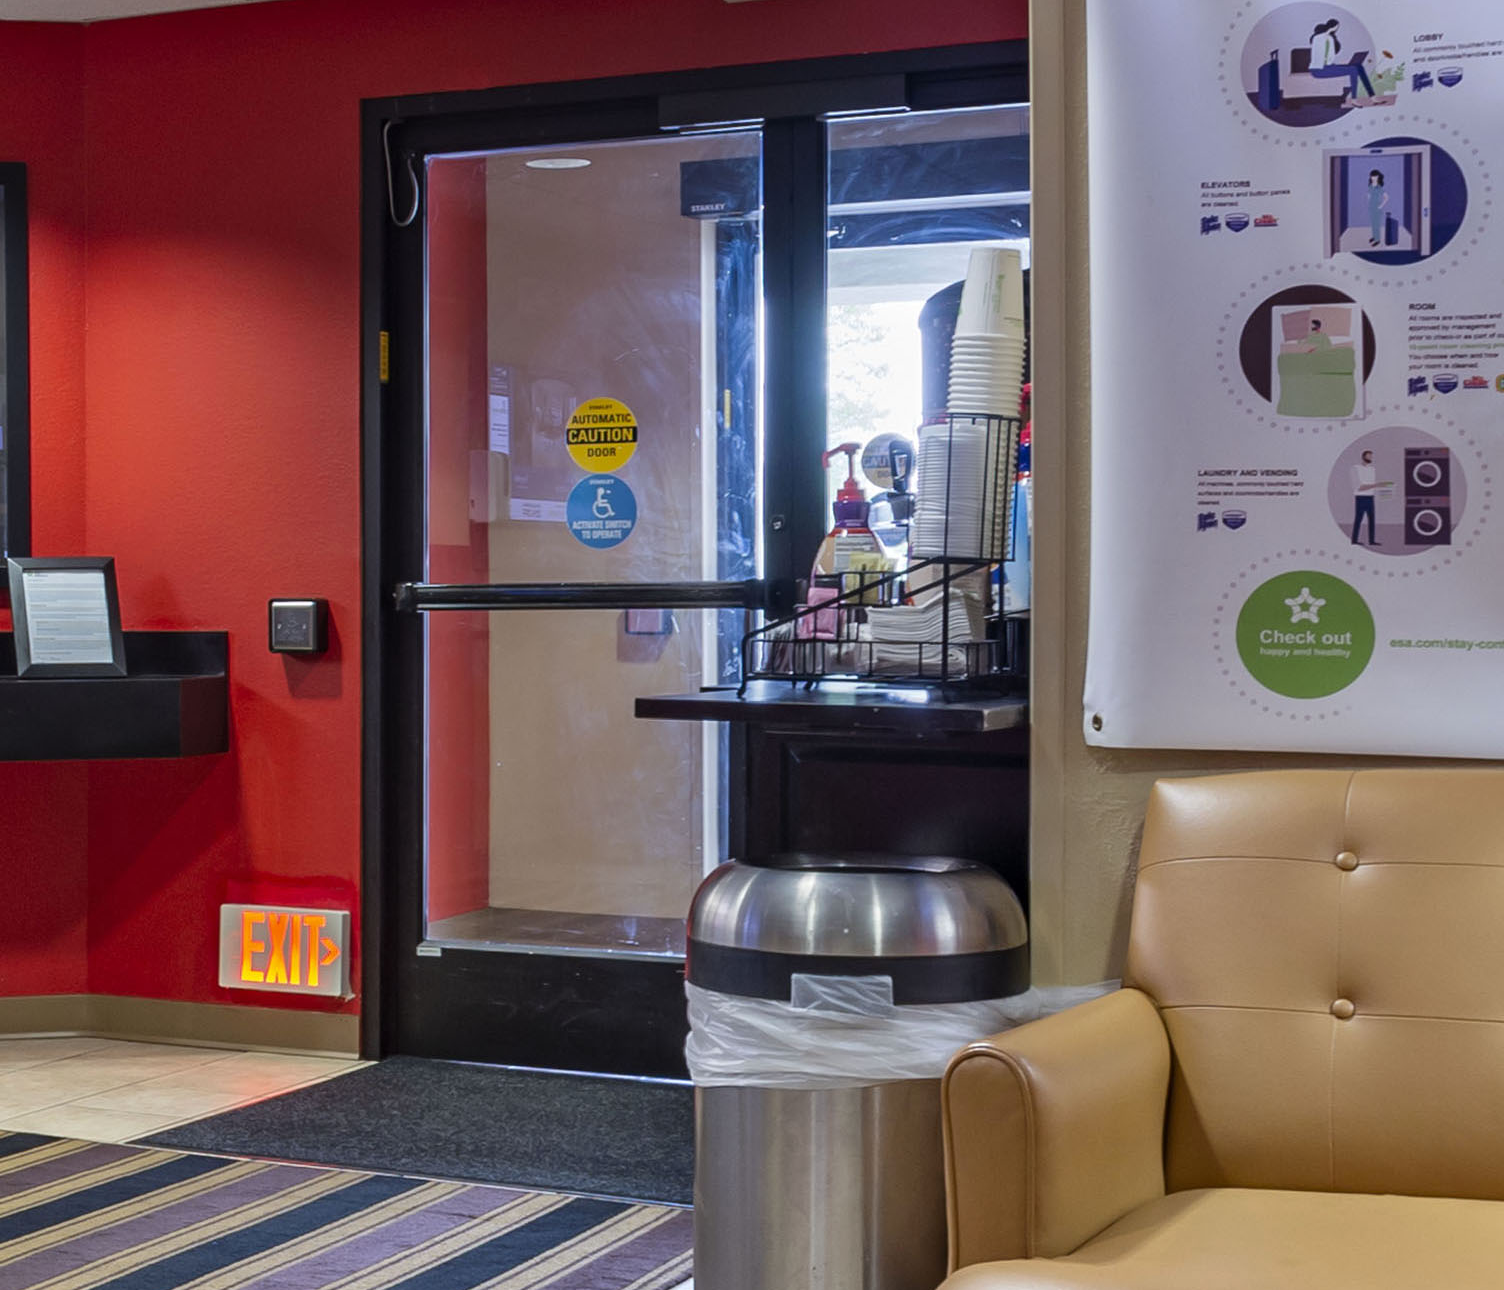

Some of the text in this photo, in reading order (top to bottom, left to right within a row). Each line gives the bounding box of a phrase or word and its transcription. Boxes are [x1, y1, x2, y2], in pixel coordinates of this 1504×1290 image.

[1413, 33, 1444, 43] LOBBY
[1200, 180, 1251, 189] ELEVATORS
[572, 413, 632, 424] AUTOMATIC
[569, 428, 633, 443] CAUTION
[587, 447, 616, 457] DOOR
[1259, 629, 1352, 645] Check out
[241, 910, 326, 987] EXIT
